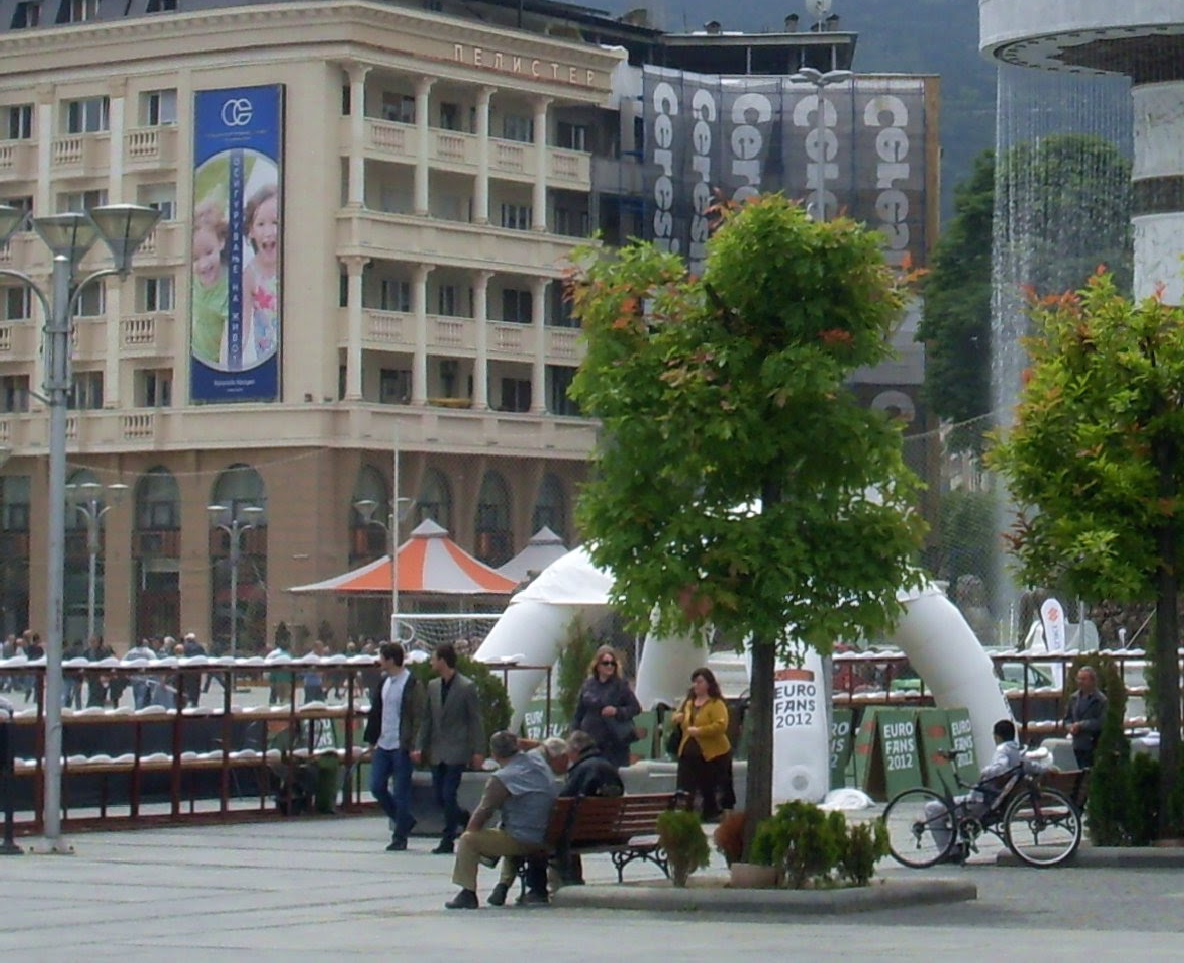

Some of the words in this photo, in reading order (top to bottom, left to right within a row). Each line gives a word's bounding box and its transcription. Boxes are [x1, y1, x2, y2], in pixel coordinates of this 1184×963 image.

[454, 43, 596, 87] ПЕЛИСТЕР
[231, 286, 239, 303] НА
[774, 684, 817, 699] EURO
[775, 700, 816, 715] FANS
[776, 713, 813, 729] 2012
[951, 719, 972, 736] EURO
[883, 721, 914, 739] EURO
[885, 738, 915, 755] FANS
[887, 753, 914, 771] 2012
